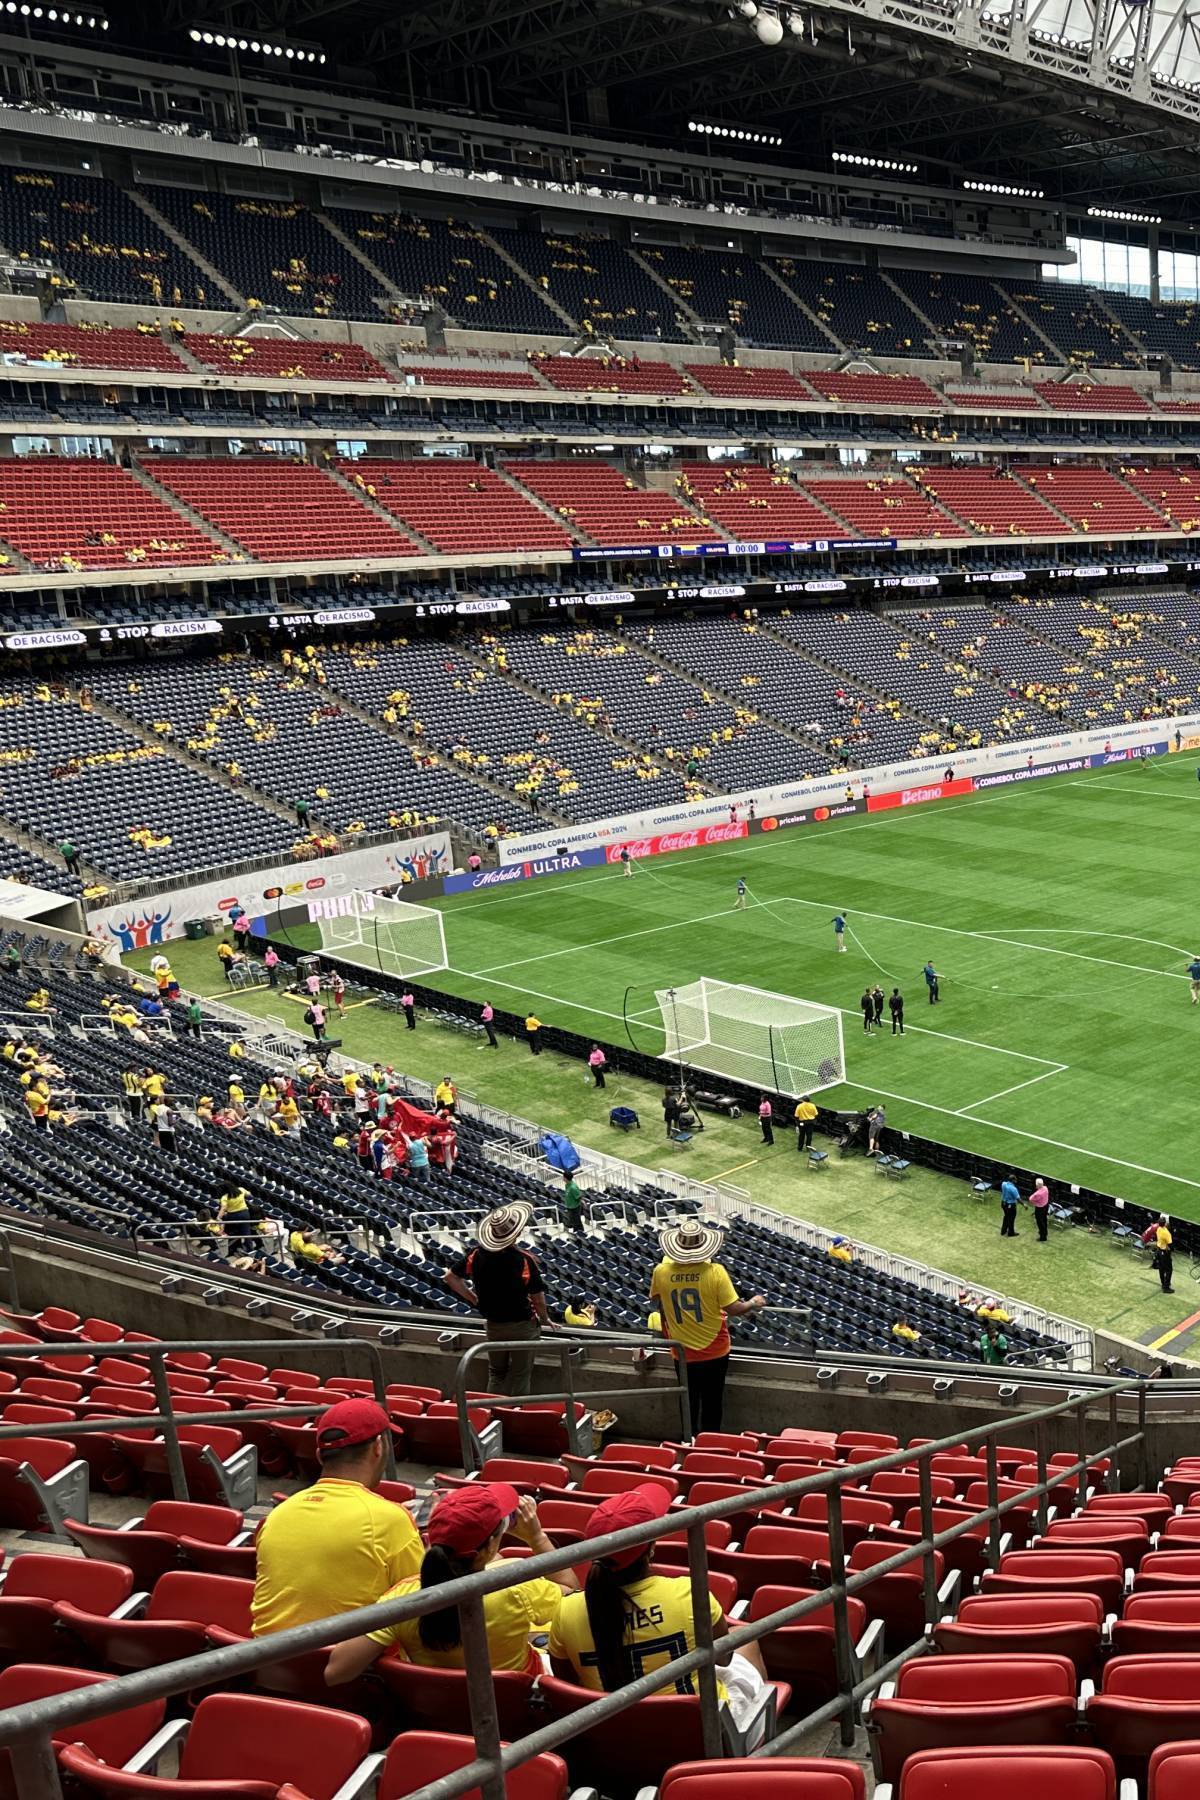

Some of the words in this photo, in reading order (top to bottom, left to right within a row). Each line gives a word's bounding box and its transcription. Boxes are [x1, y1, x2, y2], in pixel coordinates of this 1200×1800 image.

[429, 604, 454, 614] STOP
[466, 602, 499, 611] RACISM
[283, 616, 312, 625] BASTA
[332, 611, 370, 619] RACISMO
[117, 628, 149, 638] STOP
[165, 623, 207, 634] RACISM
[14, 637, 28, 647] DE
[32, 633, 80, 645] RACISMO
[894, 767, 922, 777] CONMEBOL
[981, 771, 1013, 786] CONMEBOL
[1015, 770, 1031, 781] COPA
[1029, 766, 1057, 777] AMERICA
[1057, 764, 1068, 773] USA
[781, 789, 811, 799] CONMEBOL
[811, 786, 828, 794] COPA
[828, 780, 850, 791] AMERICA
[901, 788, 942, 805] Betano
[653, 814, 687, 825] CONMEBOL
[688, 811, 705, 820] COPA
[704, 804, 732, 817] AMERICA
[830, 804, 856, 816] priceless
[779, 813, 806, 826] priceless
[507, 842, 547, 856] CONMEBOL
[547, 838, 566, 848] COPA
[565, 832, 598, 845] AMERICA
[598, 829, 610, 837] USA
[611, 825, 627, 834] 2024
[472, 866, 522, 887] Michelob
[533, 855, 580, 874] ULTRA
[670, 1288, 704, 1324] 19
